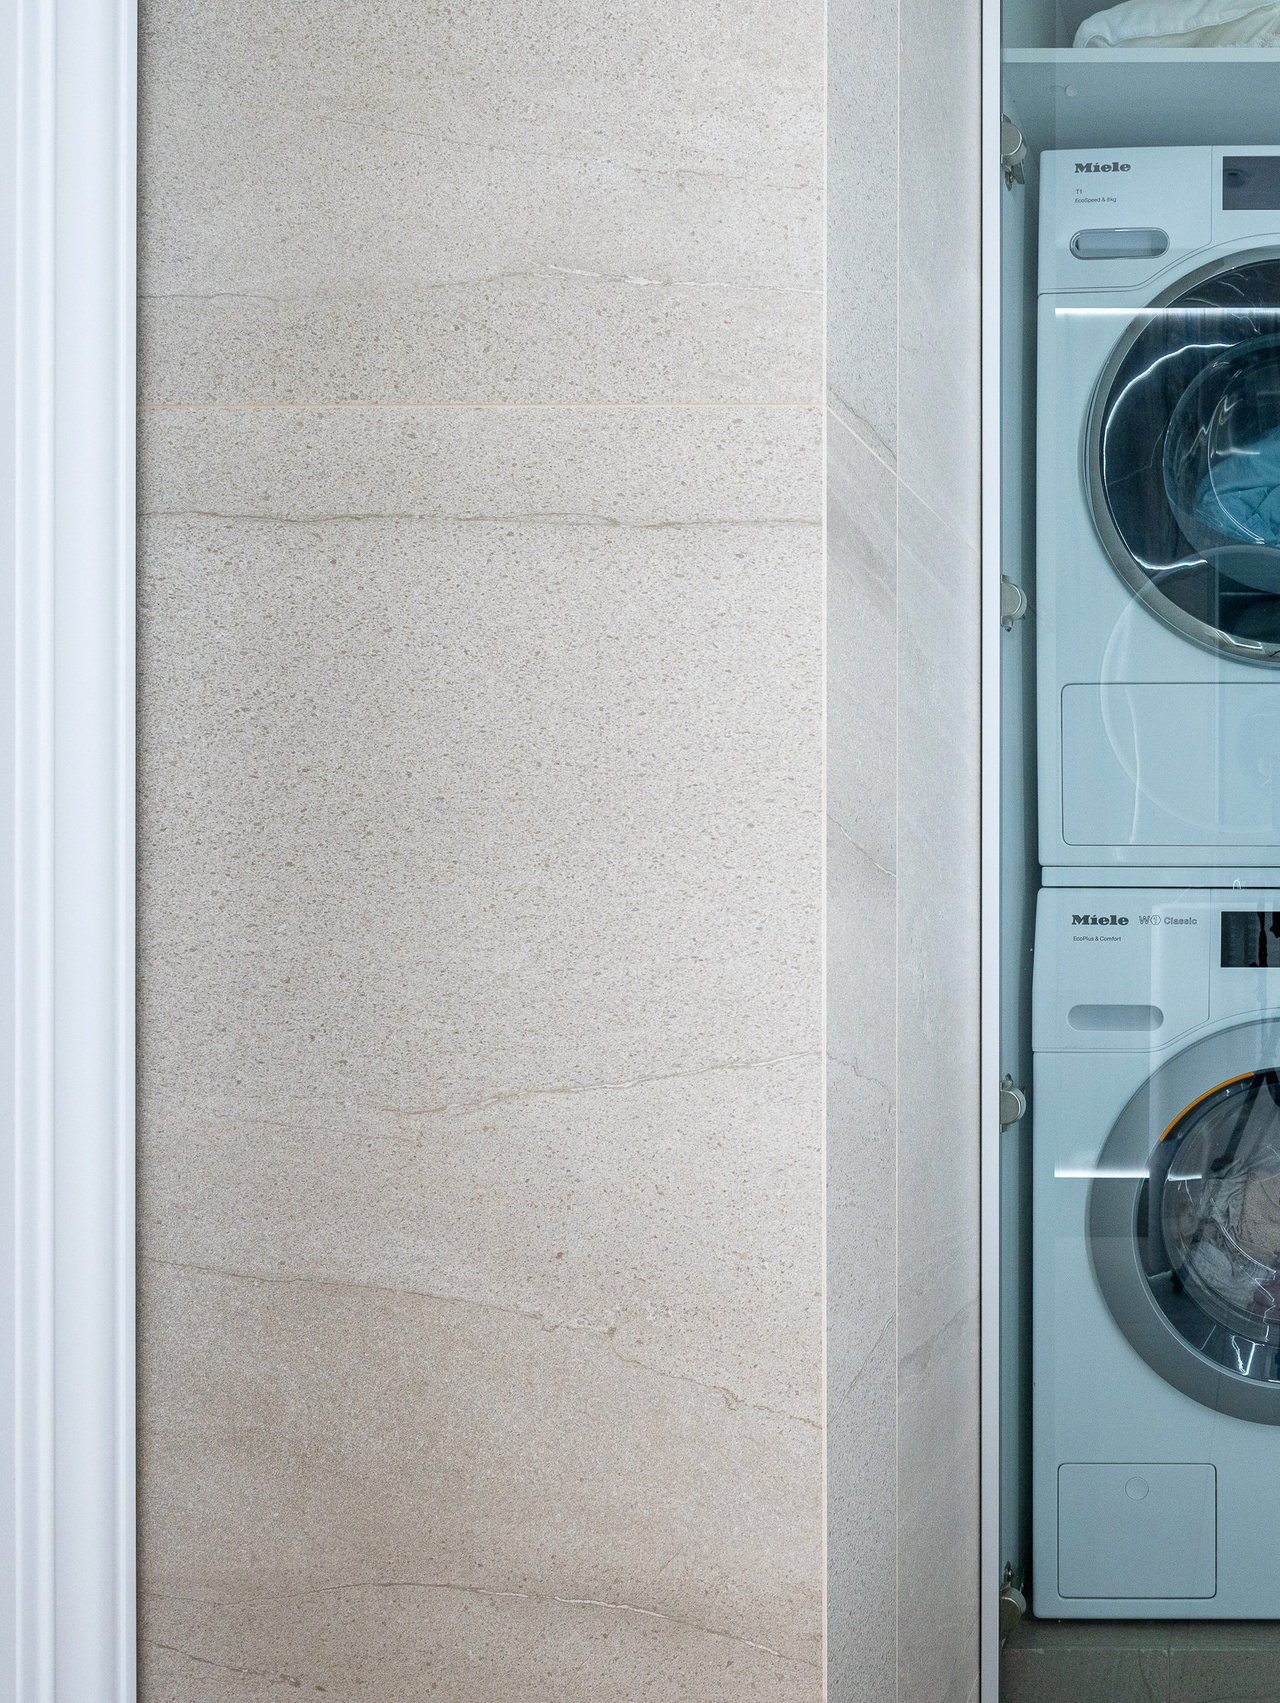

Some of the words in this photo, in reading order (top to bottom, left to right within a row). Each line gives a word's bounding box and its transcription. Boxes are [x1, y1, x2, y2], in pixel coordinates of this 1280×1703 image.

[1074, 162, 1131, 173] Miele
[1071, 914, 1129, 925] Miele
[1163, 916, 1198, 925] Classic
